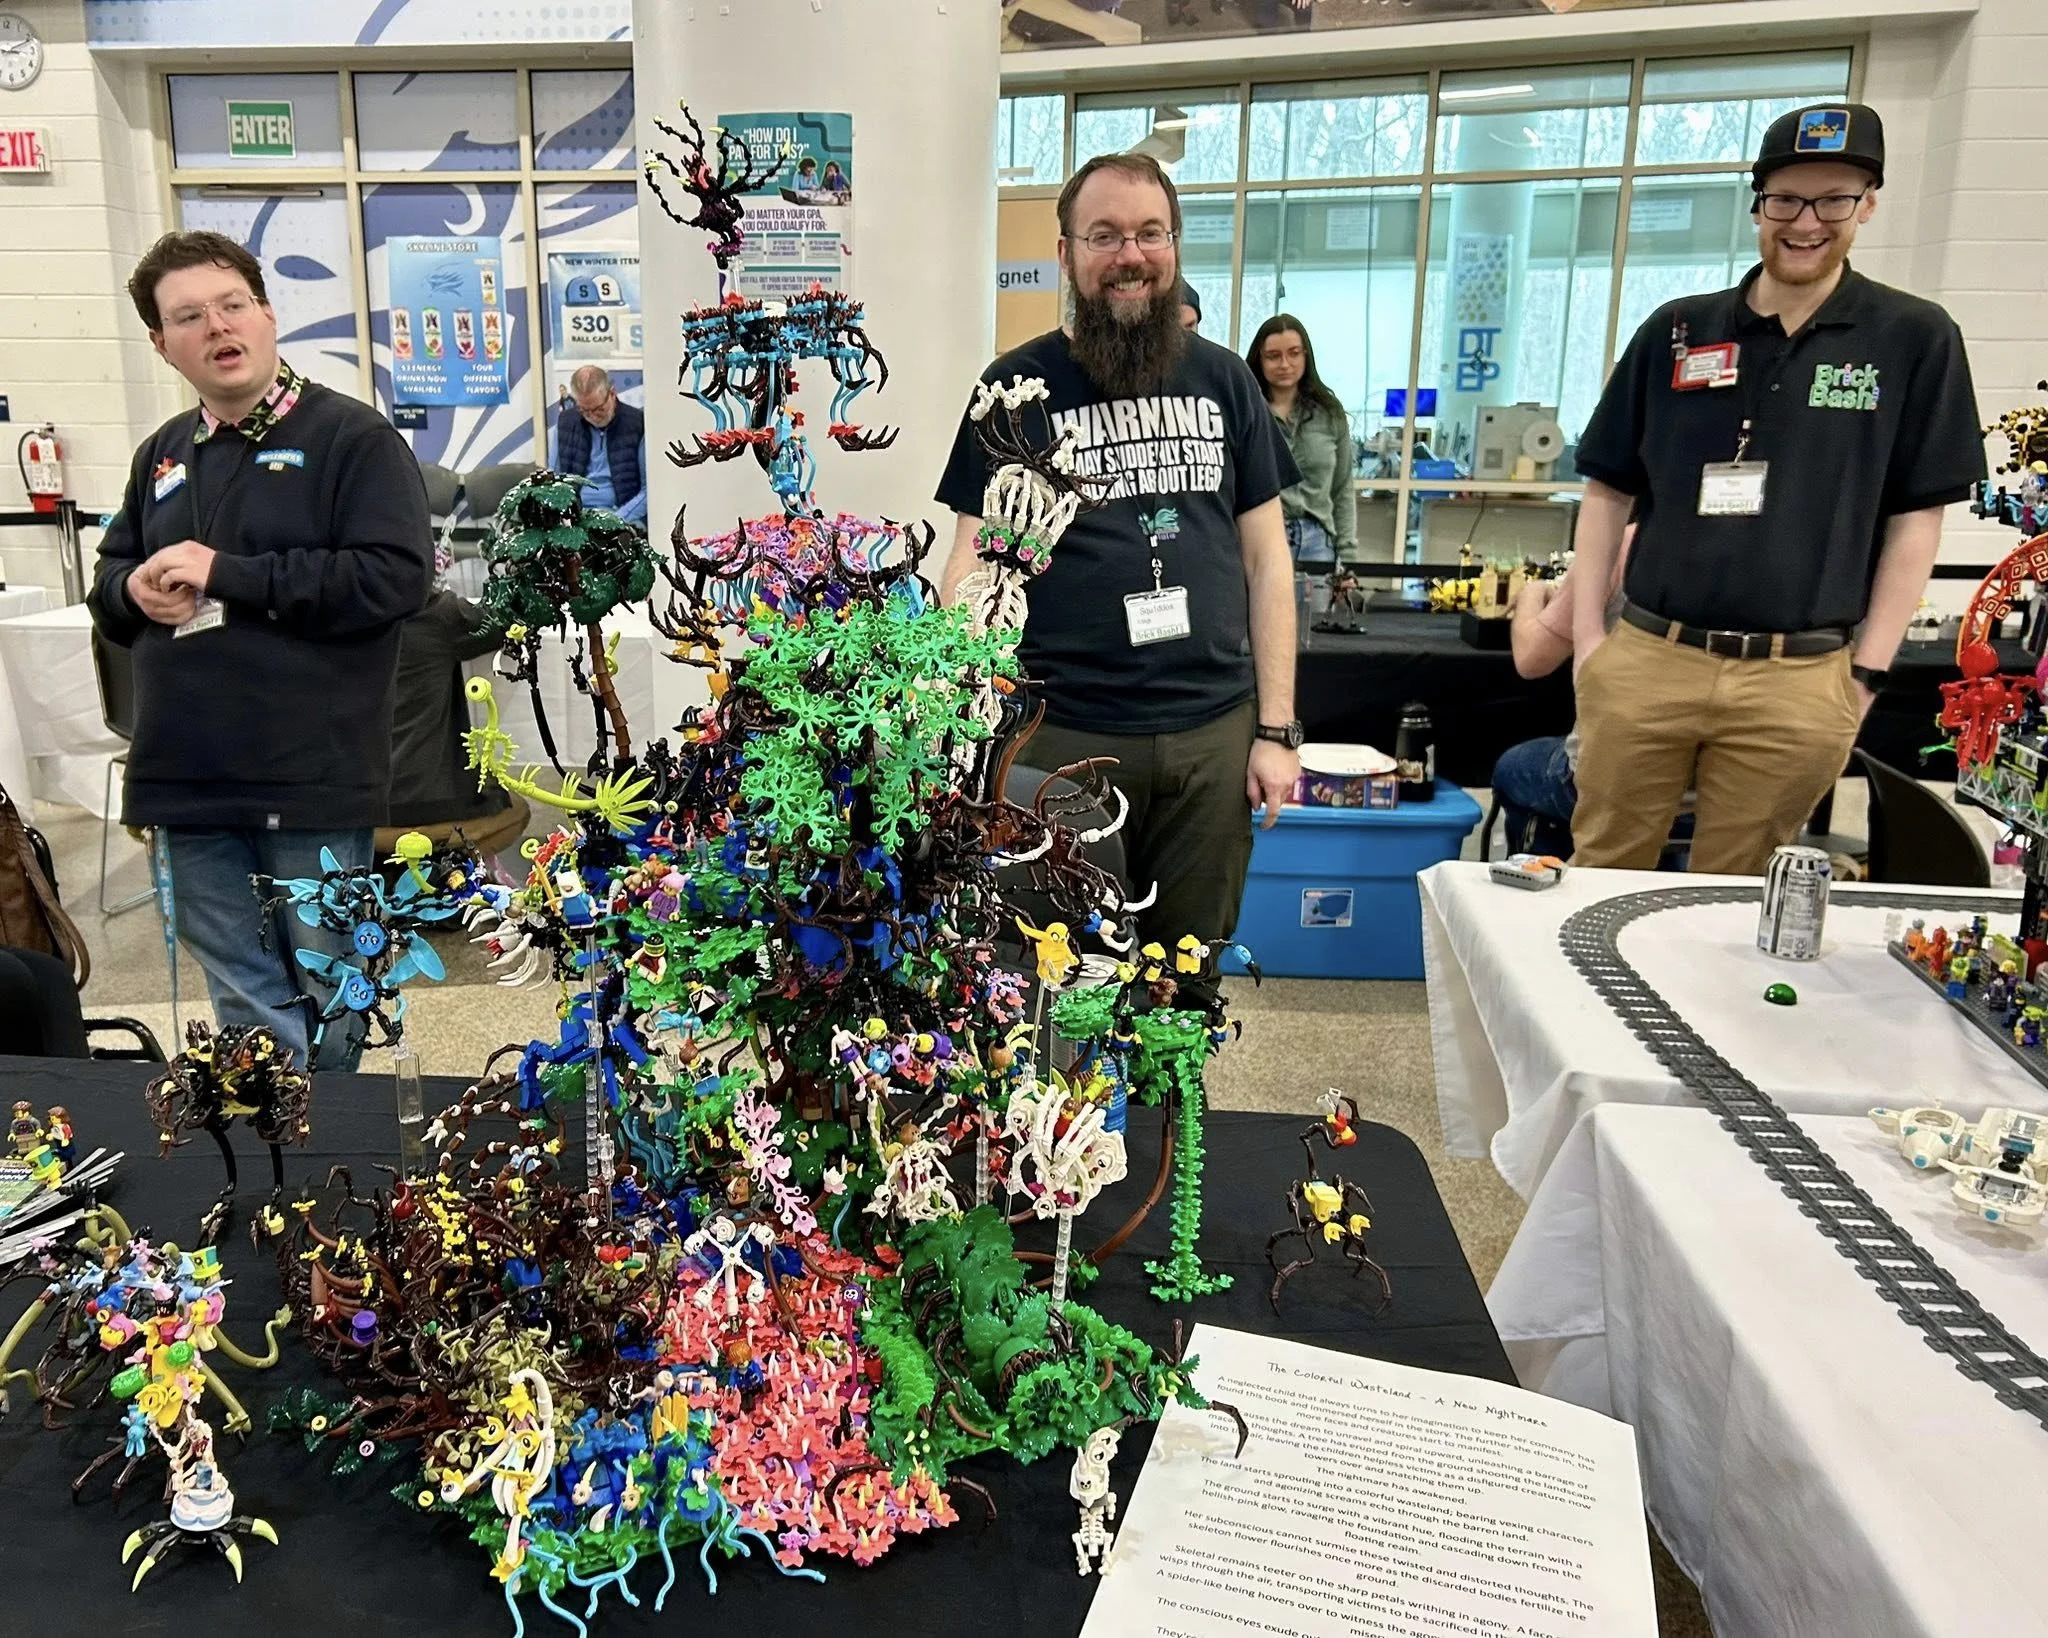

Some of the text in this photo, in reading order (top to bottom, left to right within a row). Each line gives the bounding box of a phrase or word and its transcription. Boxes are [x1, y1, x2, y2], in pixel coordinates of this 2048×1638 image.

[232, 115, 291, 145] ENTER
[0, 132, 35, 167] EXIT
[751, 144, 770, 159] FOR
[742, 220, 827, 231] YOU COULD QUALIFY FOR:
[745, 209, 755, 220] NO
[757, 209, 784, 220] MATTER
[786, 209, 805, 220] YOUR
[447, 242, 478, 252] STORE
[565, 258, 582, 266] NEW
[586, 258, 618, 266] WINTER
[579, 284, 589, 298] S
[601, 282, 611, 296] S
[999, 268, 1039, 288] gnet
[572, 315, 610, 333] $30
[396, 375, 447, 384] DRINKS NOW
[463, 375, 502, 384] DIFFERENT
[1814, 363, 1879, 388] Brick
[466, 386, 502, 394] FLAVORS
[1051, 396, 1224, 450] WARNING
[1105, 440, 1181, 474] SUDDENLY
[1182, 438, 1225, 467] START
[1137, 464, 1188, 495] ABOUT
[1189, 465, 1223, 493] LEGO
[1267, 1361, 1547, 1427] The Colorful Wasteland A New Nightmare
[1304, 1452, 1484, 1495] towers over and snatching them up.
[1317, 1466, 1467, 1504] The nightmare has awakened.
[1200, 1452, 1218, 1464] The
[1220, 1458, 1242, 1470] land
[1244, 1466, 1271, 1476] starts
[1274, 1472, 1320, 1489] sprouting
[1323, 1480, 1343, 1490] into
[1354, 1488, 1394, 1501] colorful
[1396, 1498, 1452, 1516] wasteland;
[1455, 1509, 1496, 1525] bearing
[1498, 1519, 1534, 1536] vexing
[1536, 1527, 1593, 1546] characters
[1253, 1474, 1528, 1541] and agonizing screams echo through the barren land.
[1201, 1488, 1581, 1580] hellish-pink glow, ravaging the foundation and cascading down from the
[1205, 1479, 1222, 1488] The
[1223, 1484, 1260, 1496] ground
[1262, 1493, 1290, 1503] starts
[1306, 1502, 1334, 1514] surge
[1337, 1508, 1360, 1518] with
[1372, 1516, 1408, 1530] vibrant
[1411, 1524, 1434, 1537] hue,
[1438, 1531, 1483, 1548] flooding
[1486, 1541, 1504, 1551] the
[1507, 1546, 1544, 1560] terrain
[1547, 1555, 1572, 1566] with
[1344, 1530, 1421, 1555] floating realm.
[1184, 1509, 1594, 1611] Her subconscious cannot surmise these twisted and distorted thoughts. The
[1188, 1522, 1231, 1536] skeleton
[1234, 1531, 1268, 1544] flower
[1270, 1539, 1322, 1557] flourishes
[1324, 1553, 1351, 1564] once
[1353, 1560, 1383, 1572] more
[1400, 1570, 1419, 1580] the
[1421, 1569, 1476, 1594] discarded
[1479, 1588, 1517, 1604] bodies
[1520, 1598, 1563, 1615] fertilize
[1566, 1610, 1586, 1621] the
